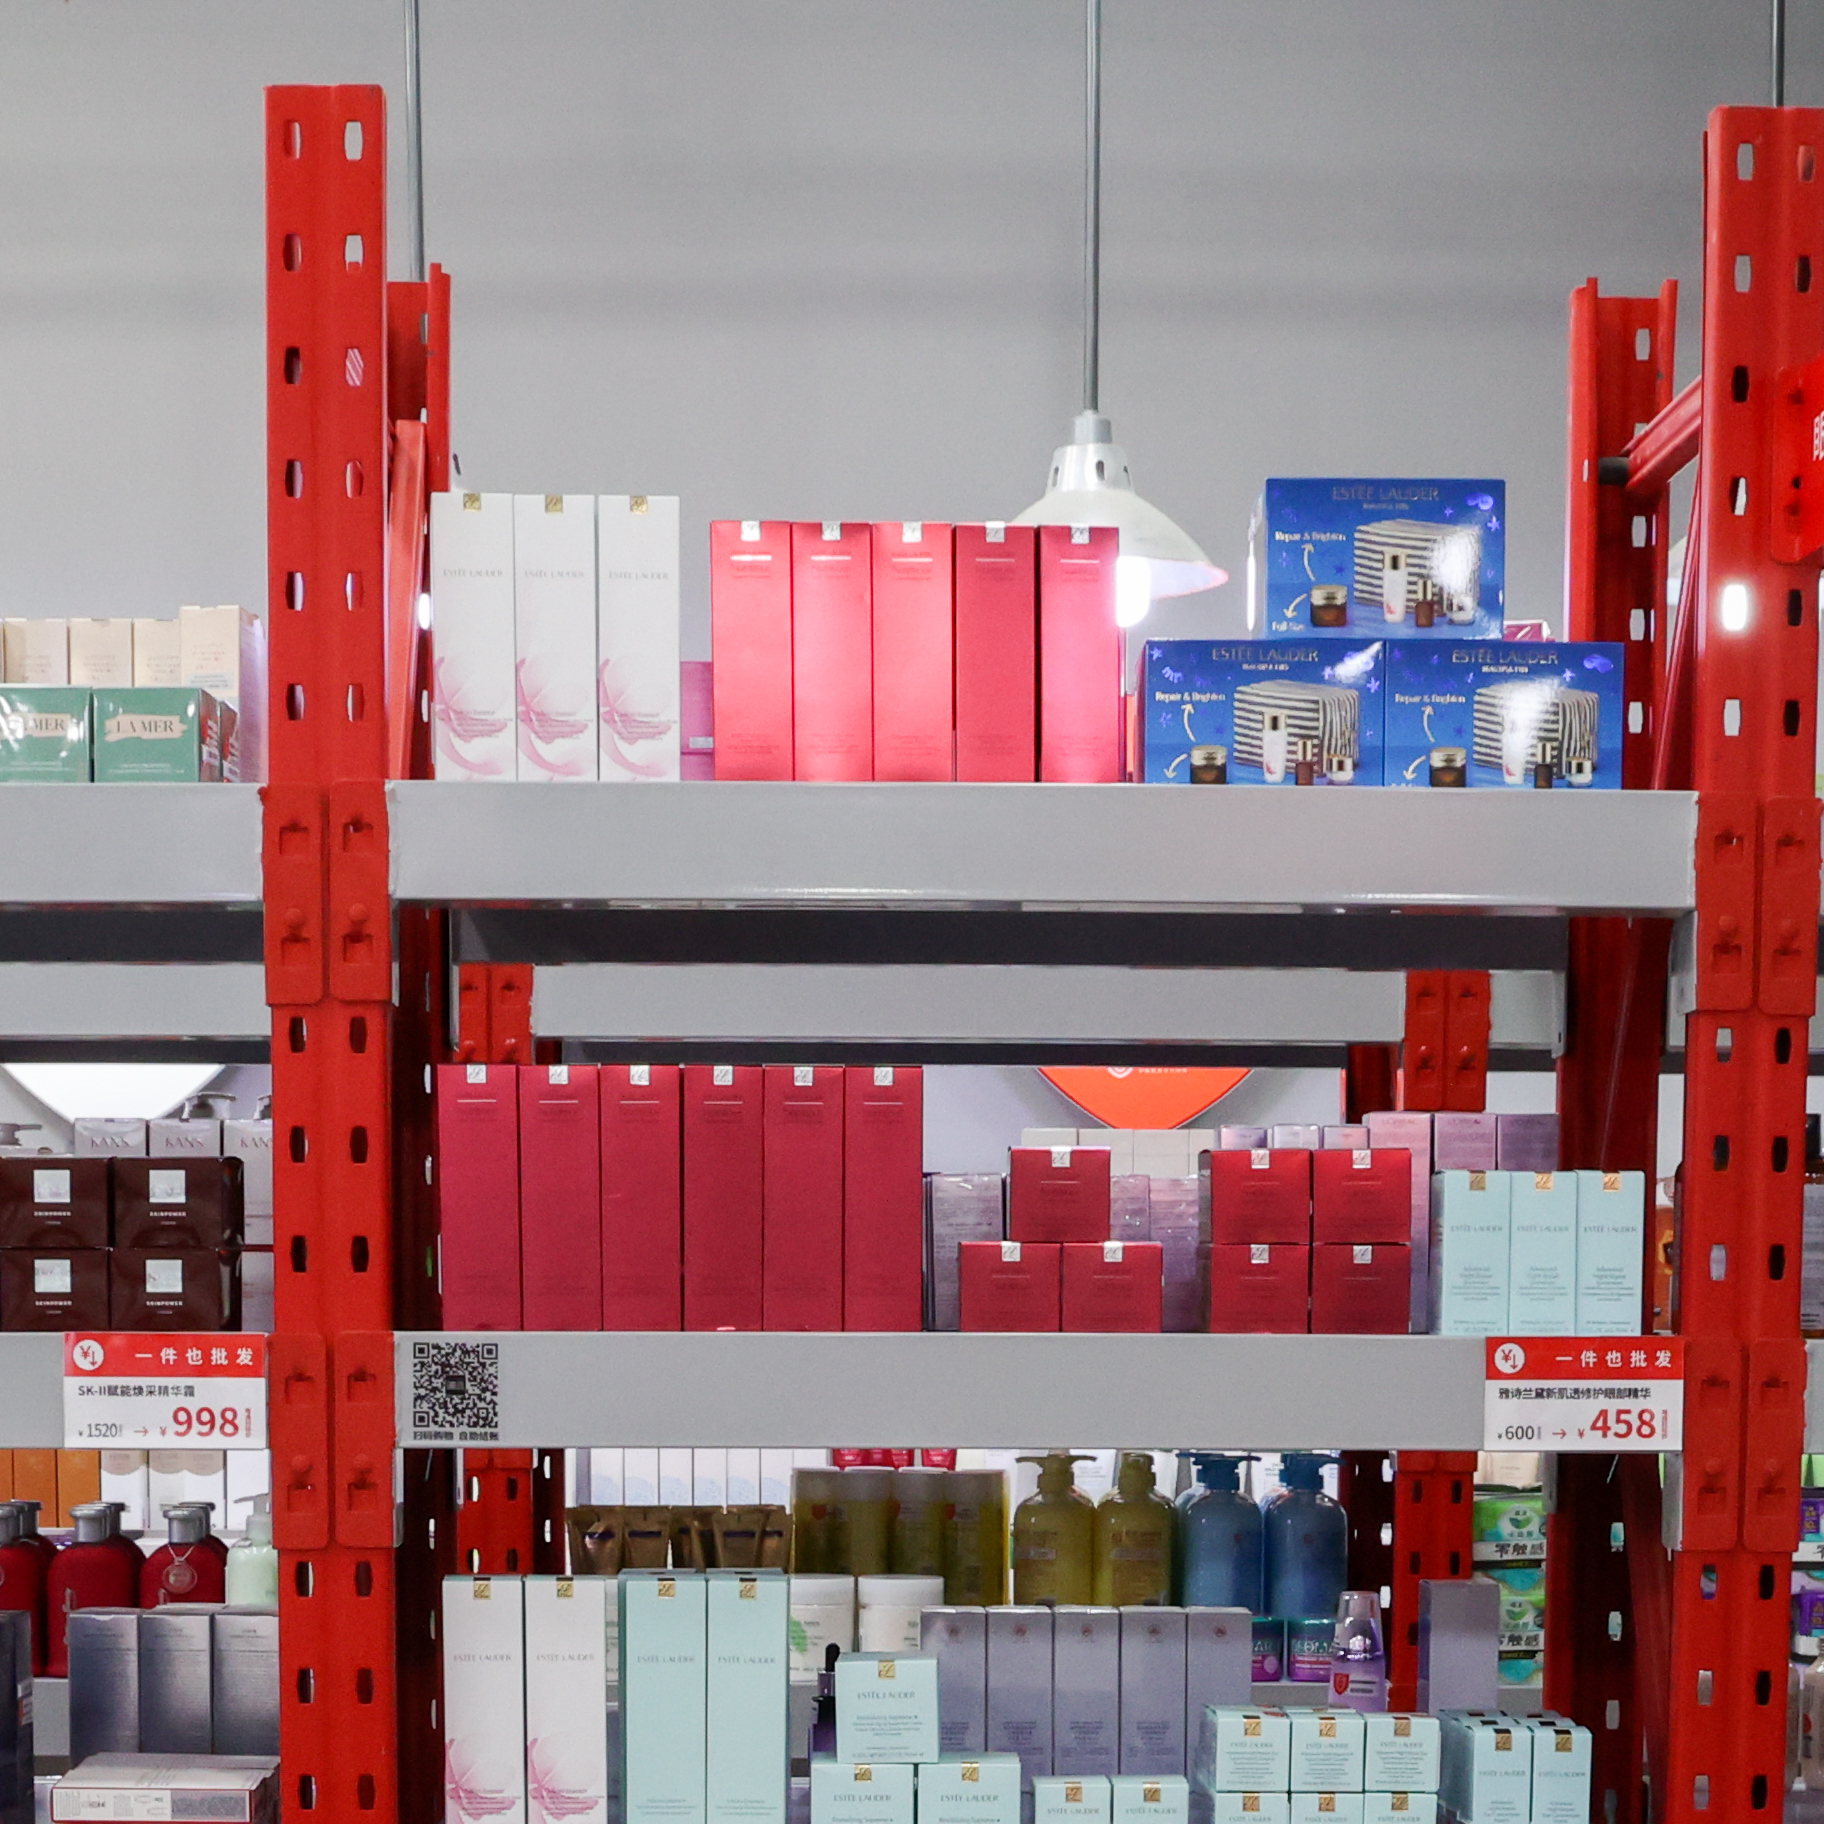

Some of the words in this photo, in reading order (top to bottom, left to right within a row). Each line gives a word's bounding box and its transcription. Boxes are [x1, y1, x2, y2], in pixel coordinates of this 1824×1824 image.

[134, 1347, 253, 1366] 一件也批发
[1555, 1350, 1672, 1368] 一件也批发
